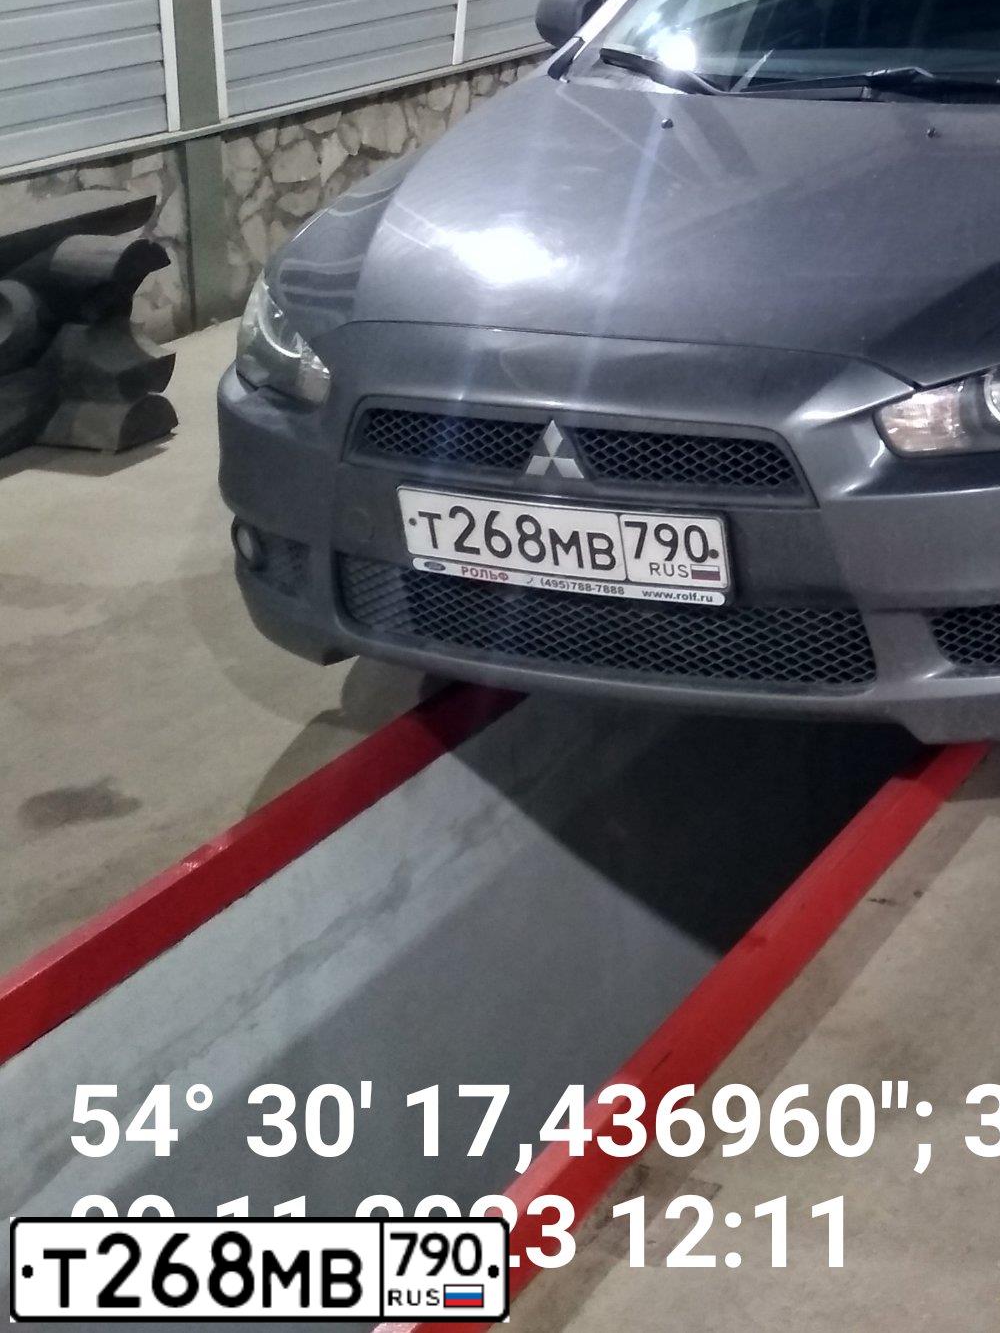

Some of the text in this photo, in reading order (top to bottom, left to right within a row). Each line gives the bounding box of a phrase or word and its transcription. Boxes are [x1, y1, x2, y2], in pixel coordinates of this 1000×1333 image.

[624, 520, 710, 564] 790
[460, 565, 509, 582] РОЛЬФ
[641, 589, 714, 603] www.rolf.ru
[649, 561, 690, 579] RUS
